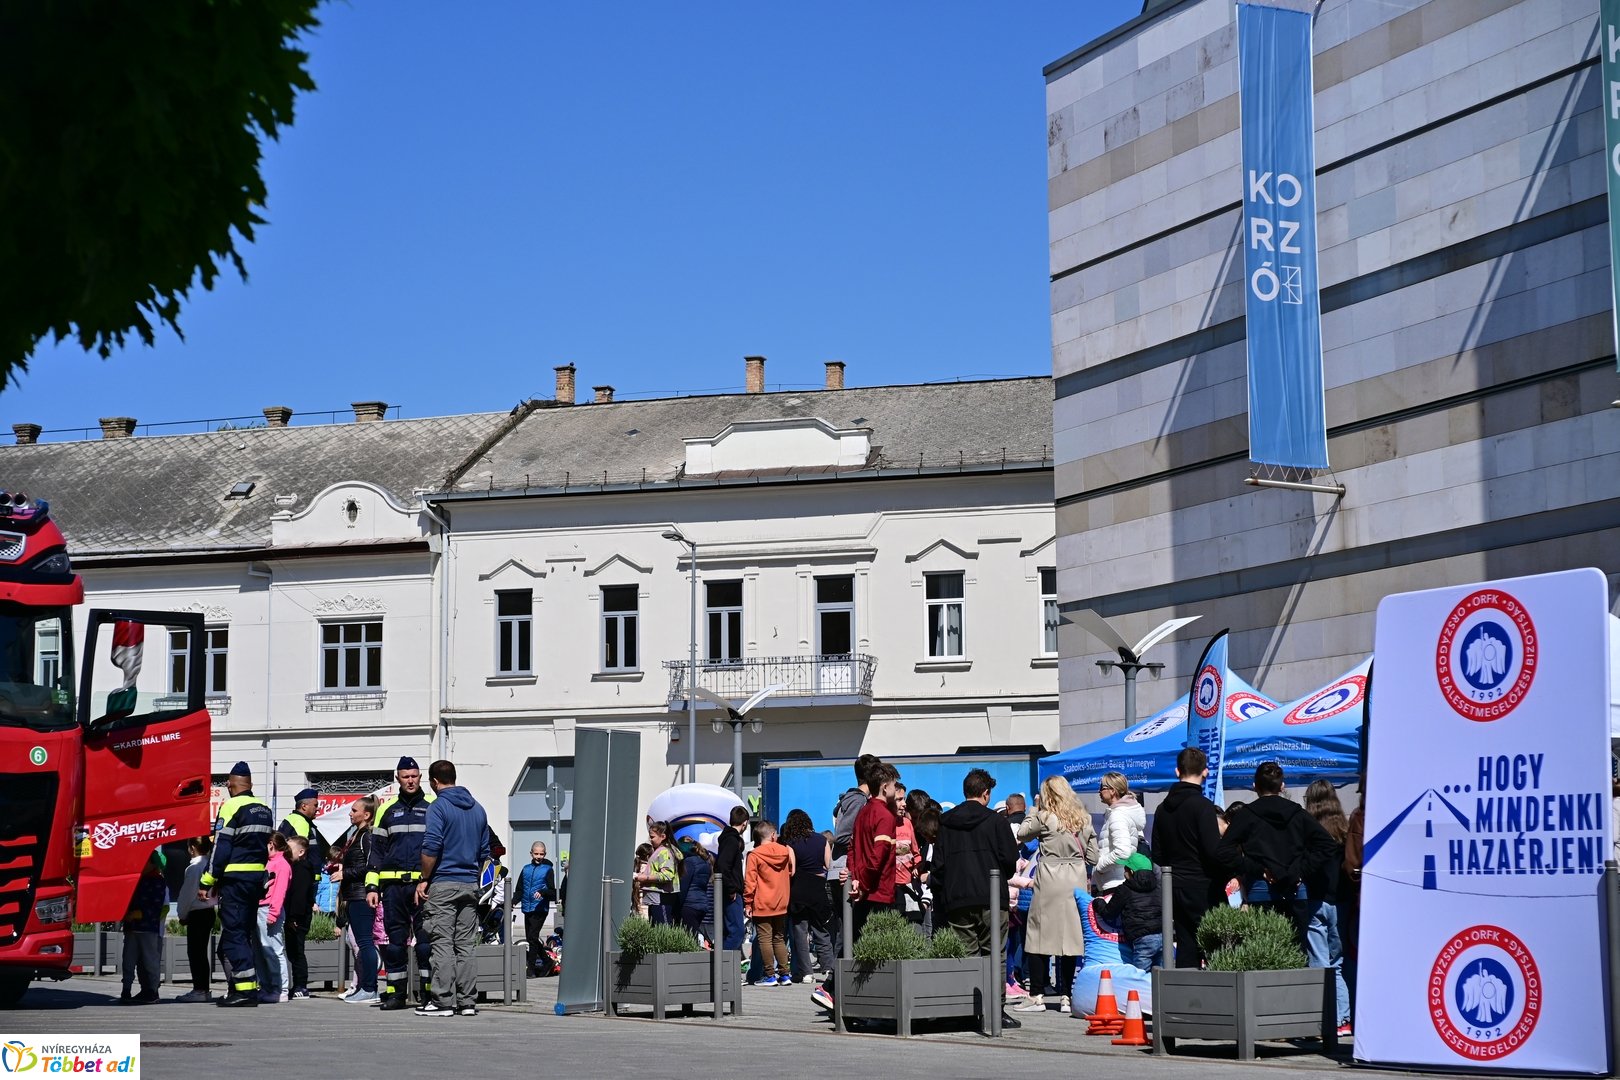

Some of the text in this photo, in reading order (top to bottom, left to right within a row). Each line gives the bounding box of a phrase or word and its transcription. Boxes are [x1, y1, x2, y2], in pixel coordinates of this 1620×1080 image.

[1472, 594, 1499, 606] ORFK
[1471, 687, 1503, 701] 1992
[119, 732, 181, 749] KARDINÁL IMRE
[34, 750, 42, 762] 6
[1476, 793, 1603, 833] MINDENKI
[120, 819, 166, 836] REVESZ
[130, 828, 177, 843] RACING
[1449, 832, 1604, 875] HAZAÉRJEN!
[1471, 929, 1501, 942] ORFK
[1466, 1026, 1503, 1040] 1992
